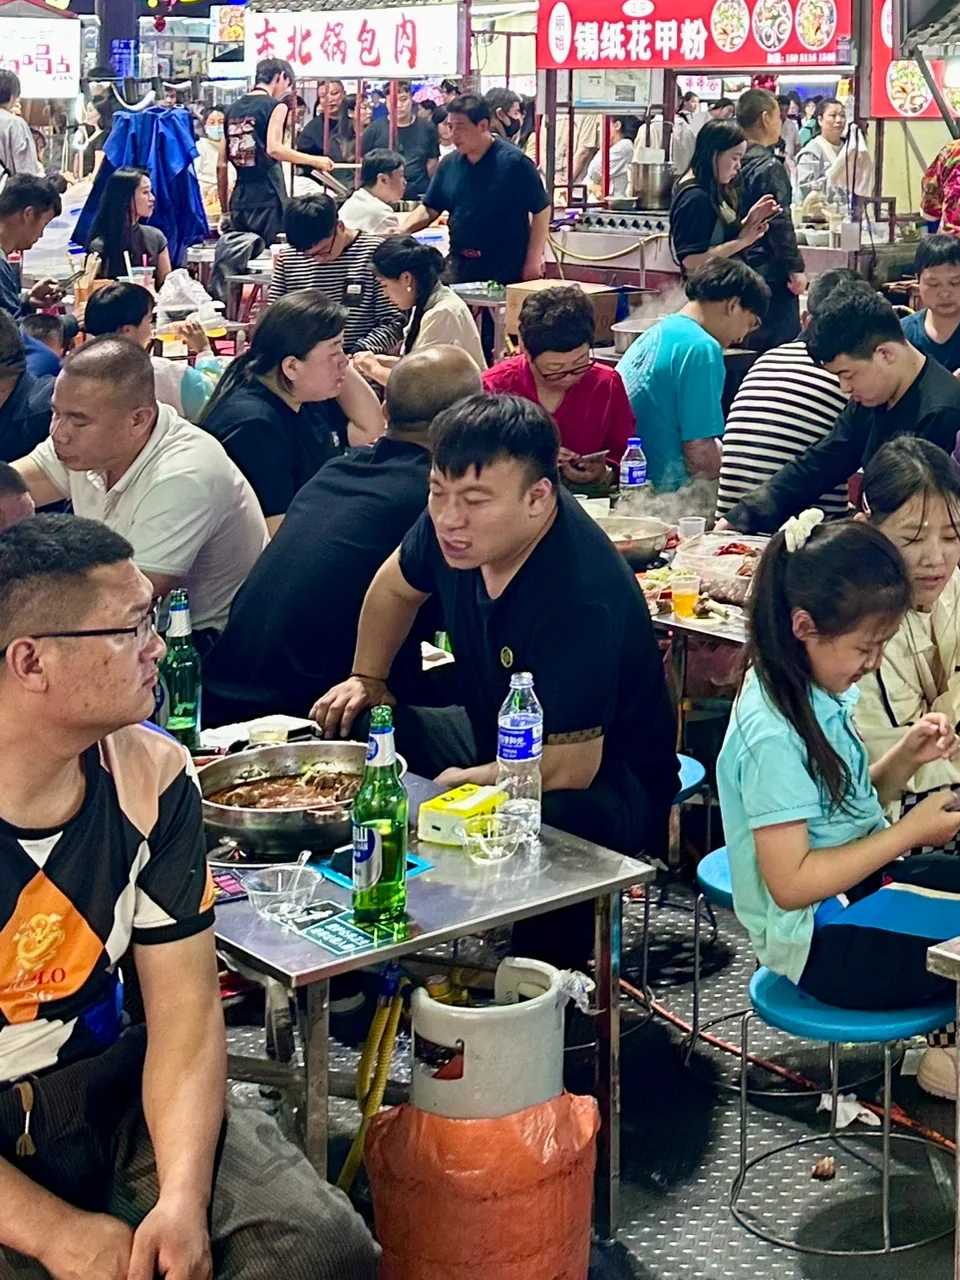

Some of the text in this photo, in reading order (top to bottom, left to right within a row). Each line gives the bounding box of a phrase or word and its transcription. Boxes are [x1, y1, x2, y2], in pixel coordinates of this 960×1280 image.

[255, 12, 418, 70] 东北锅包肉
[574, 18, 708, 61] 锡纸花甲粉
